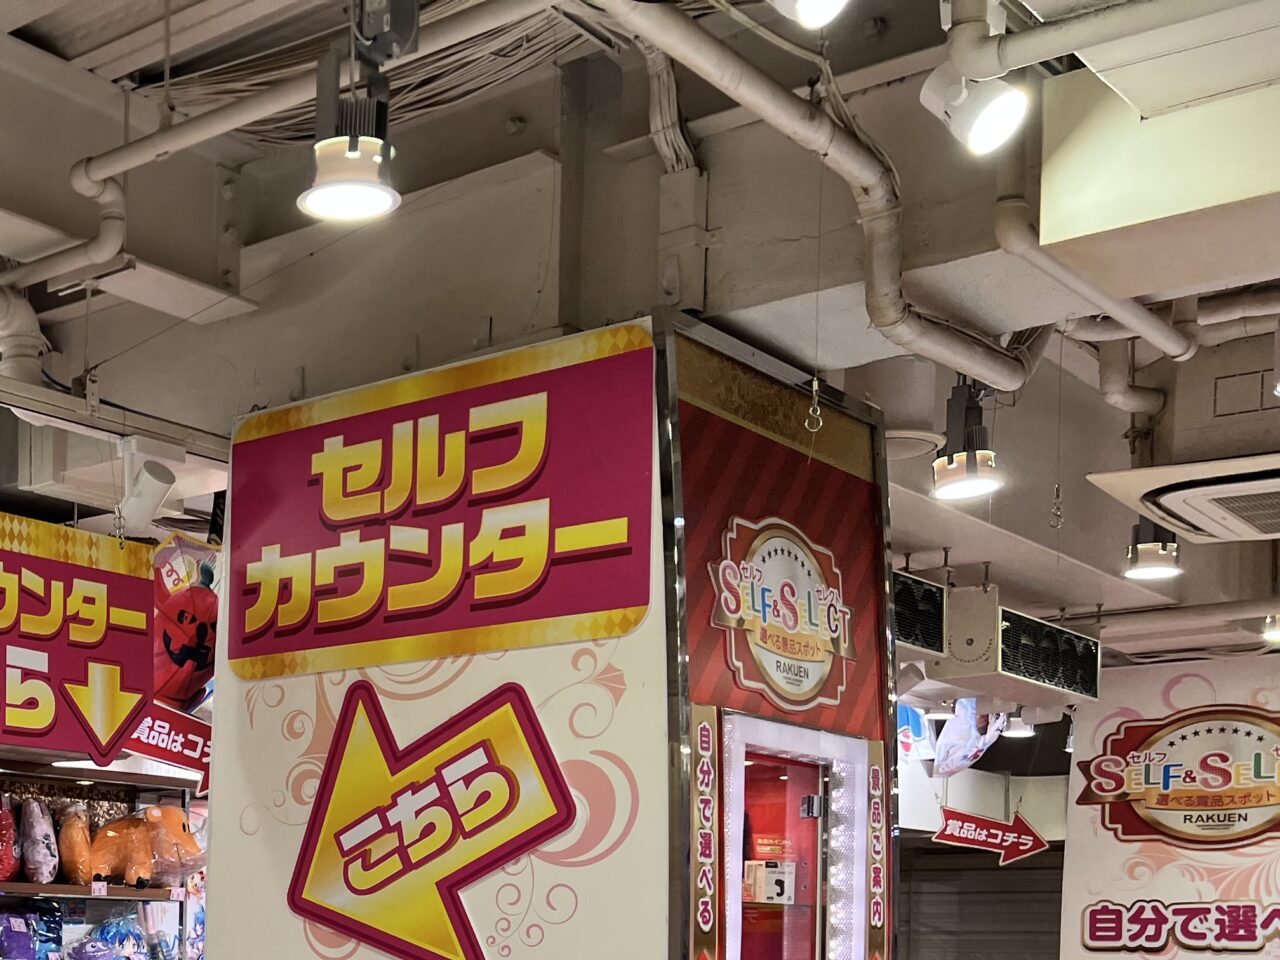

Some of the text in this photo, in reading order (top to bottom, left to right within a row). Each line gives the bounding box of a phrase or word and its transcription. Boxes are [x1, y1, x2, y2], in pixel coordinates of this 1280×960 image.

[311, 392, 548, 521] セルフ
[245, 498, 628, 633] カウンター
[741, 564, 762, 581] セルフ
[776, 660, 809, 679] RAKUEN
[1092, 752, 1280, 795] SELF&SEL
[1129, 752, 1167, 764] セルフ
[339, 746, 516, 891] こちら
[699, 724, 713, 925] 自分で選べる
[944, 820, 1034, 850] 賞品はコチラ
[1183, 813, 1248, 824] RAKUEN
